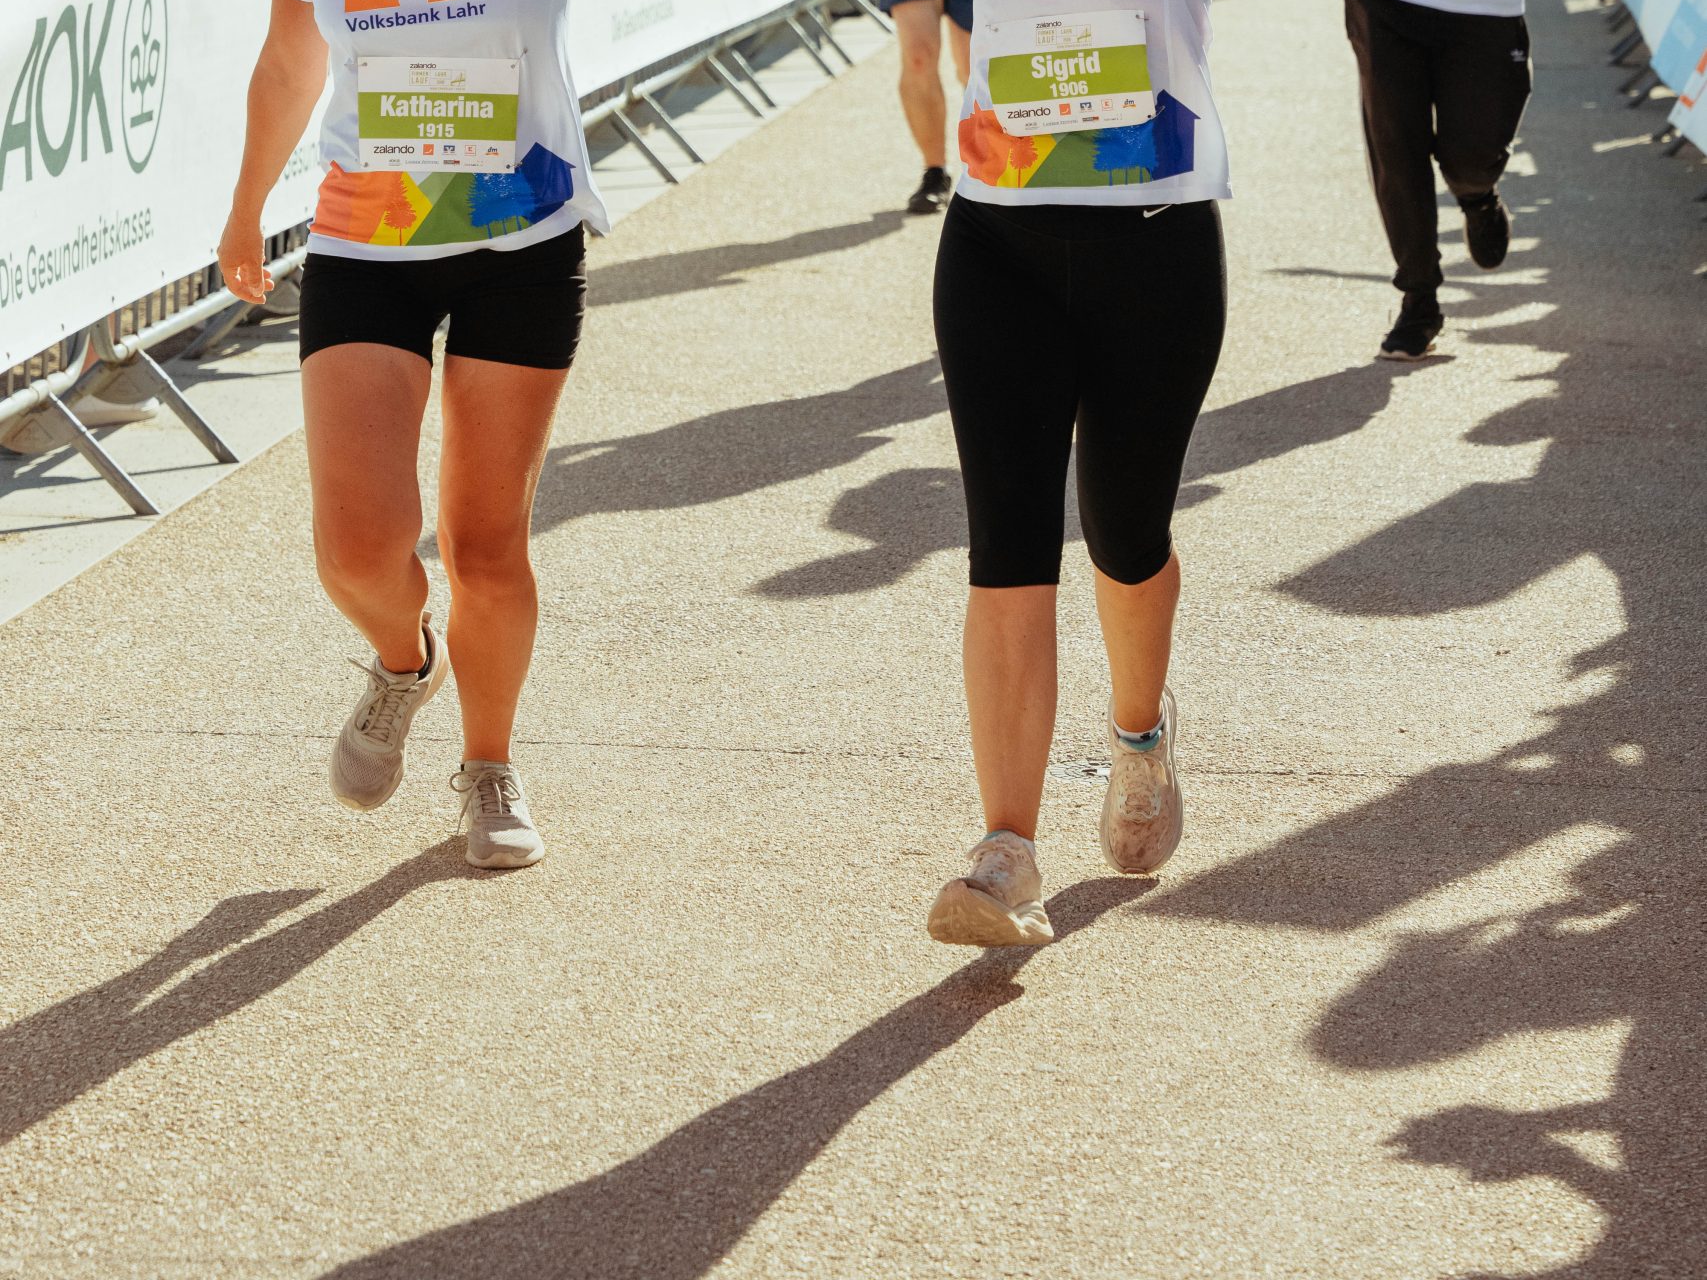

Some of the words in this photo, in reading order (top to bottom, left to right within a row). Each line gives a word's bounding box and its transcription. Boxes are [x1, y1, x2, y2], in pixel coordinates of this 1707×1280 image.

[345, 7, 441, 33] Volksbank
[446, 1, 486, 20] Lahr
[1036, 20, 1062, 29] zalando
[1031, 51, 1101, 82] Sigrid
[1049, 81, 1089, 98] 1906
[380, 94, 494, 119] Katharina
[1007, 106, 1051, 120] zalando
[417, 123, 455, 138] 1915
[373, 144, 415, 154] zalando
[0, 251, 23, 309] Die
